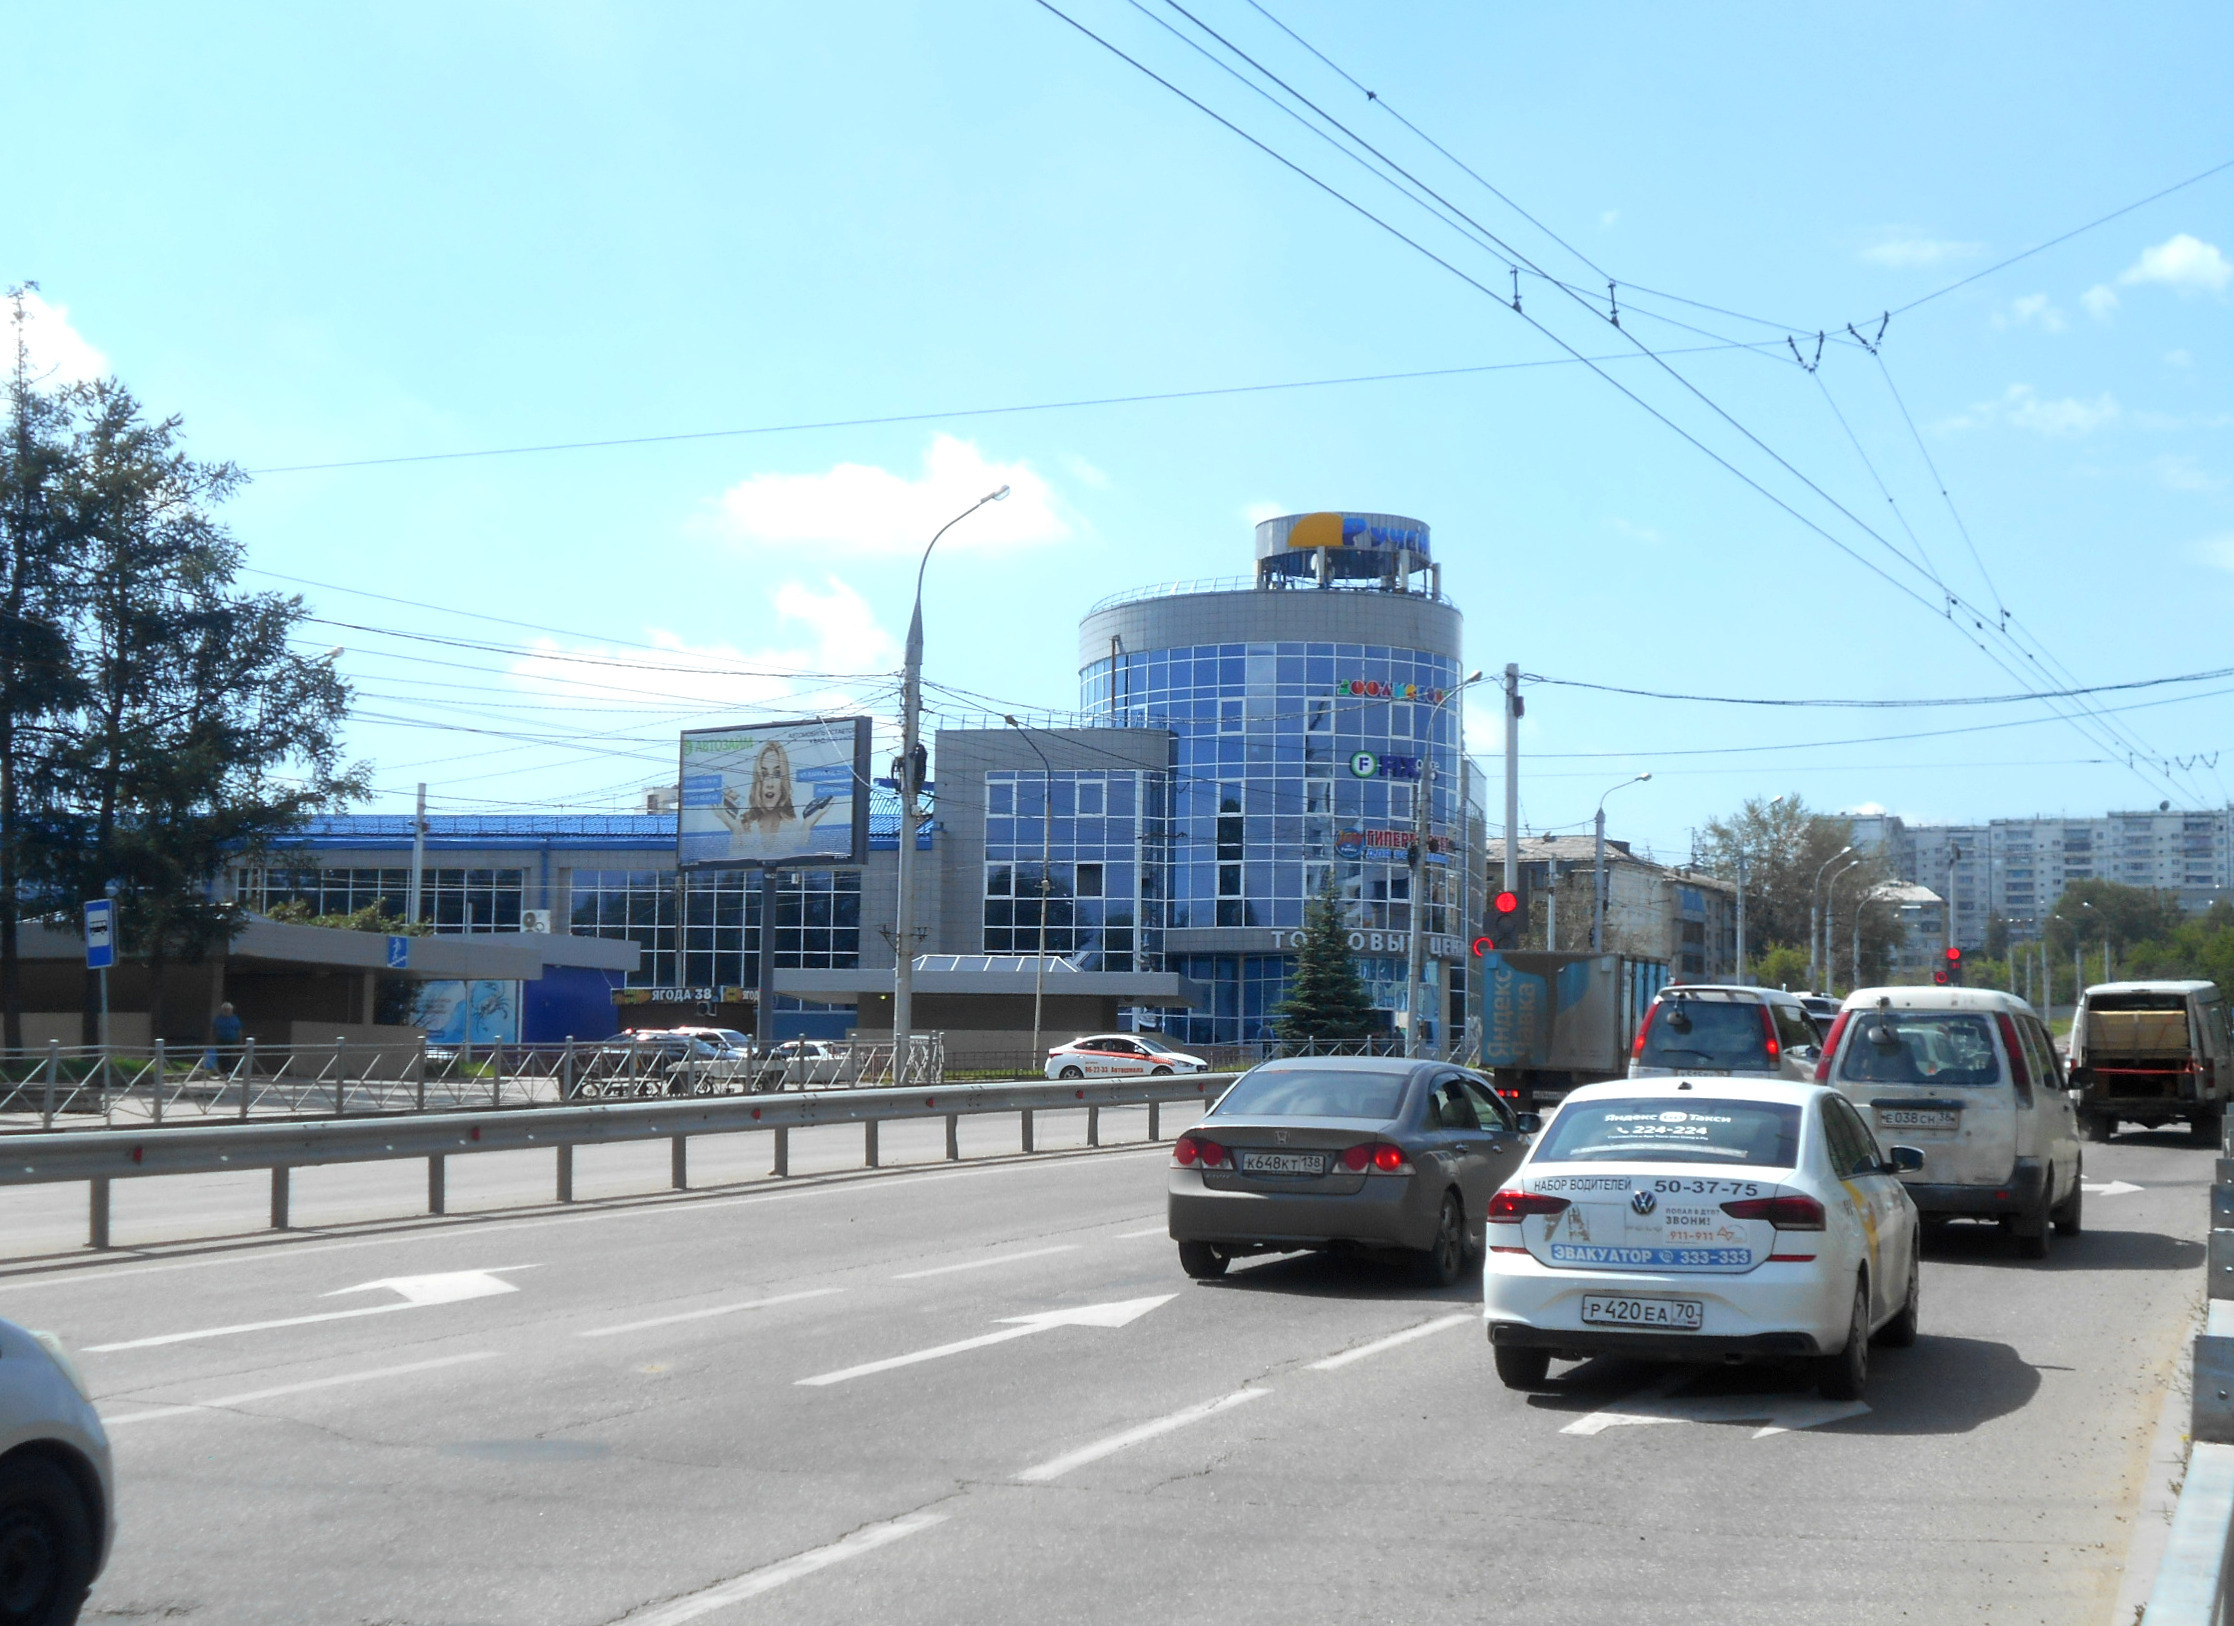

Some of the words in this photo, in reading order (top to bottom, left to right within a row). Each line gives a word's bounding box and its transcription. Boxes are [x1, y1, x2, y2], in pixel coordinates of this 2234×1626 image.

[1358, 757, 1370, 771] F
[652, 989, 692, 1002] ЯГОДА
[694, 988, 712, 999] 38
[1604, 1114, 1658, 1122] Яндекс
[1690, 1113, 1732, 1123] Такси
[1632, 1125, 1708, 1135] 224-224
[1302, 1156, 1321, 1168] 138
[1534, 1179, 1568, 1192] НАБОР
[1570, 1177, 1632, 1192] ВОДИТЕЛЕЙ
[1654, 1180, 1759, 1197] 50-37-75
[1665, 1207, 1693, 1215] ПОПАЛ
[1665, 1216, 1711, 1226] ЗВОНИ!
[1669, 1231, 1714, 1241] 911-911
[1553, 1245, 1653, 1264] ЭВАКУАТОР
[1680, 1250, 1749, 1264] 333-333
[1676, 1303, 1695, 1319] 70
